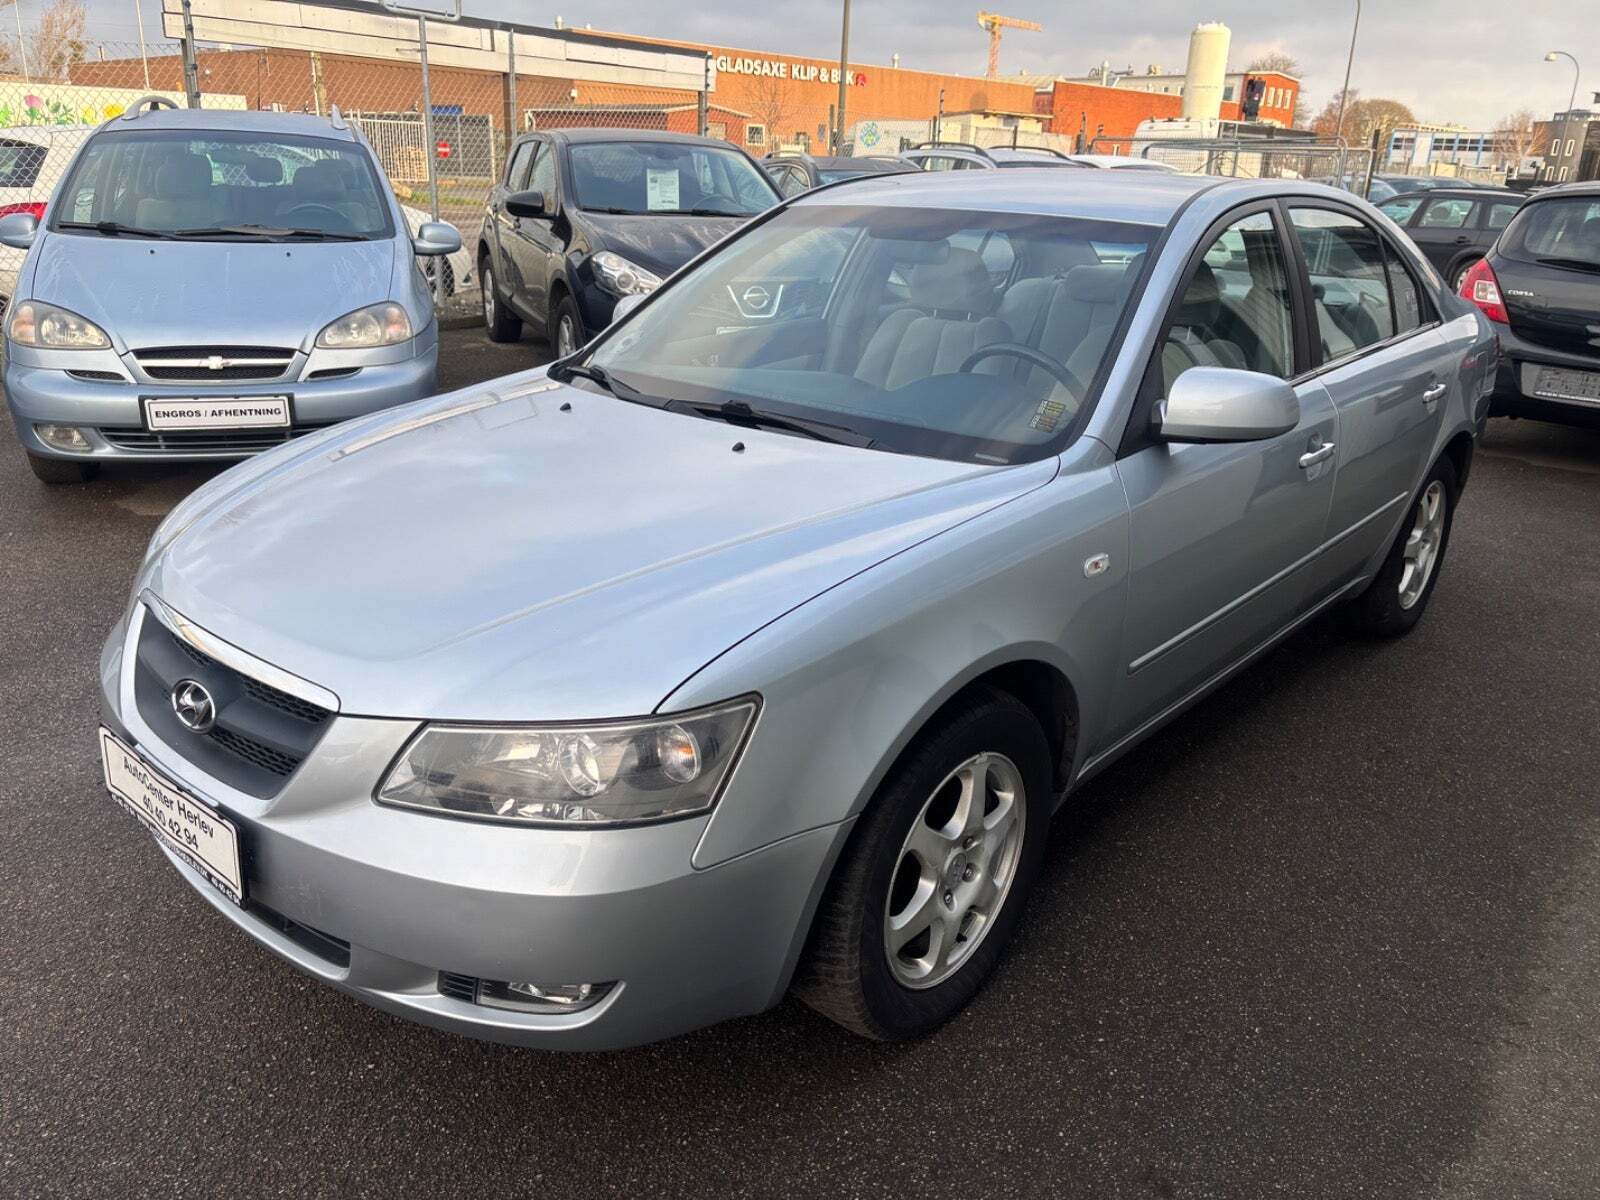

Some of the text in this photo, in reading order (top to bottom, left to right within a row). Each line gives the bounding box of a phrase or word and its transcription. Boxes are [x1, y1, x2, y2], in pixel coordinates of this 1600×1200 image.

[717, 56, 787, 78] GLADSAXE
[791, 64, 818, 82] KLIP
[819, 69, 829, 83] &
[155, 407, 282, 418] ENGROS / AFHENTNING
[123, 756, 174, 809] AutoCenter
[177, 801, 214, 839] Herlev
[143, 795, 154, 815] 40
[155, 808, 167, 827] 40
[168, 819, 184, 841] 42
[184, 829, 199, 850] 94
